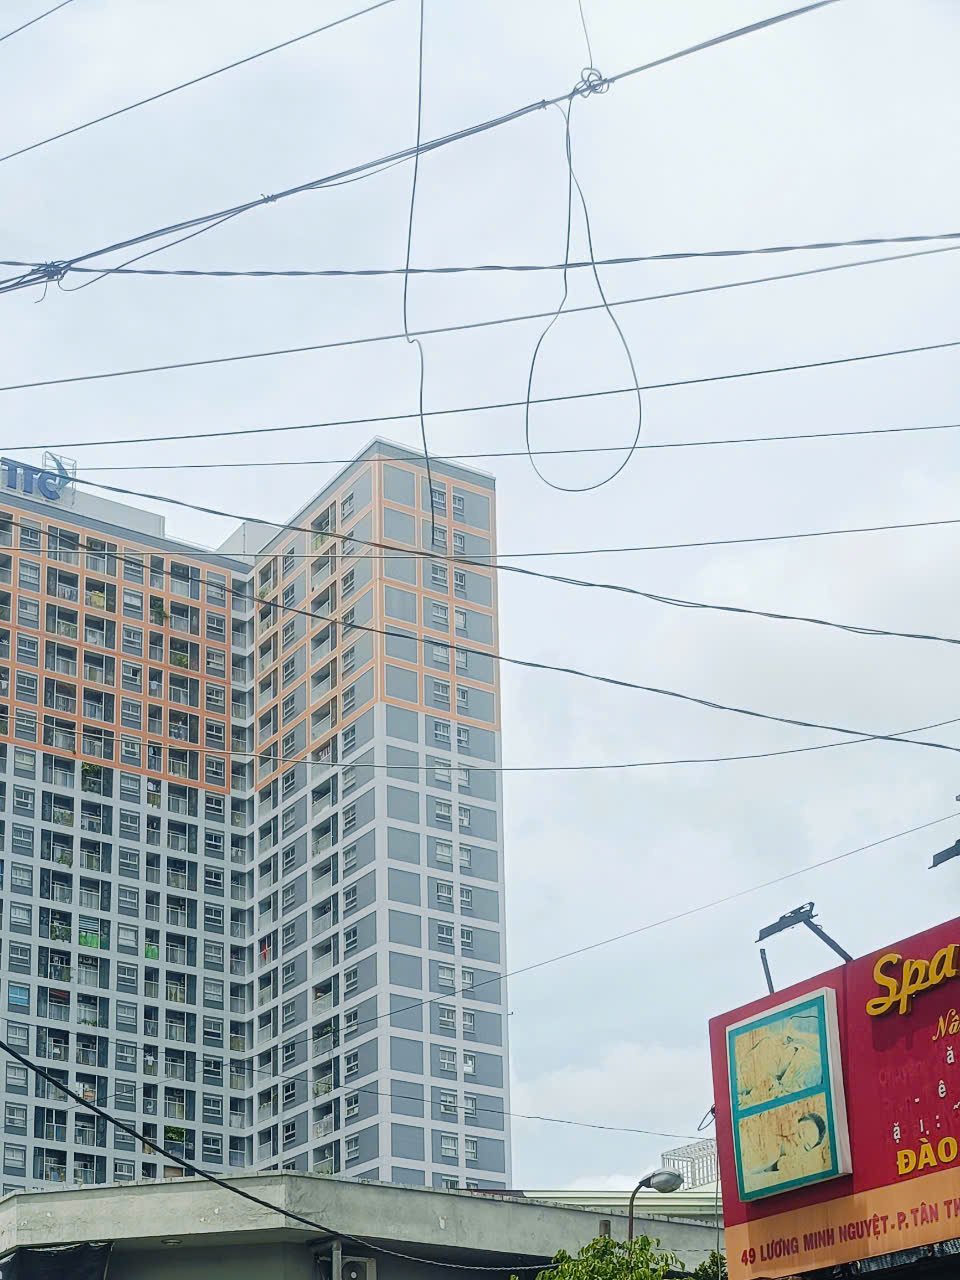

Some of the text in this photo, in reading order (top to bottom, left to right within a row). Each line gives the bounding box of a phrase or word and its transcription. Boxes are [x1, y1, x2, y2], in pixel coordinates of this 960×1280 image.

[1, 457, 60, 500] TTC
[866, 944, 957, 1015] Spa
[897, 1137, 958, 1175] ĐÀO
[741, 1247, 757, 1266] 49
[760, 1237, 799, 1262] LƯƠNG
[803, 1227, 835, 1252] MINH
[839, 1213, 889, 1241] NGUYỆT
